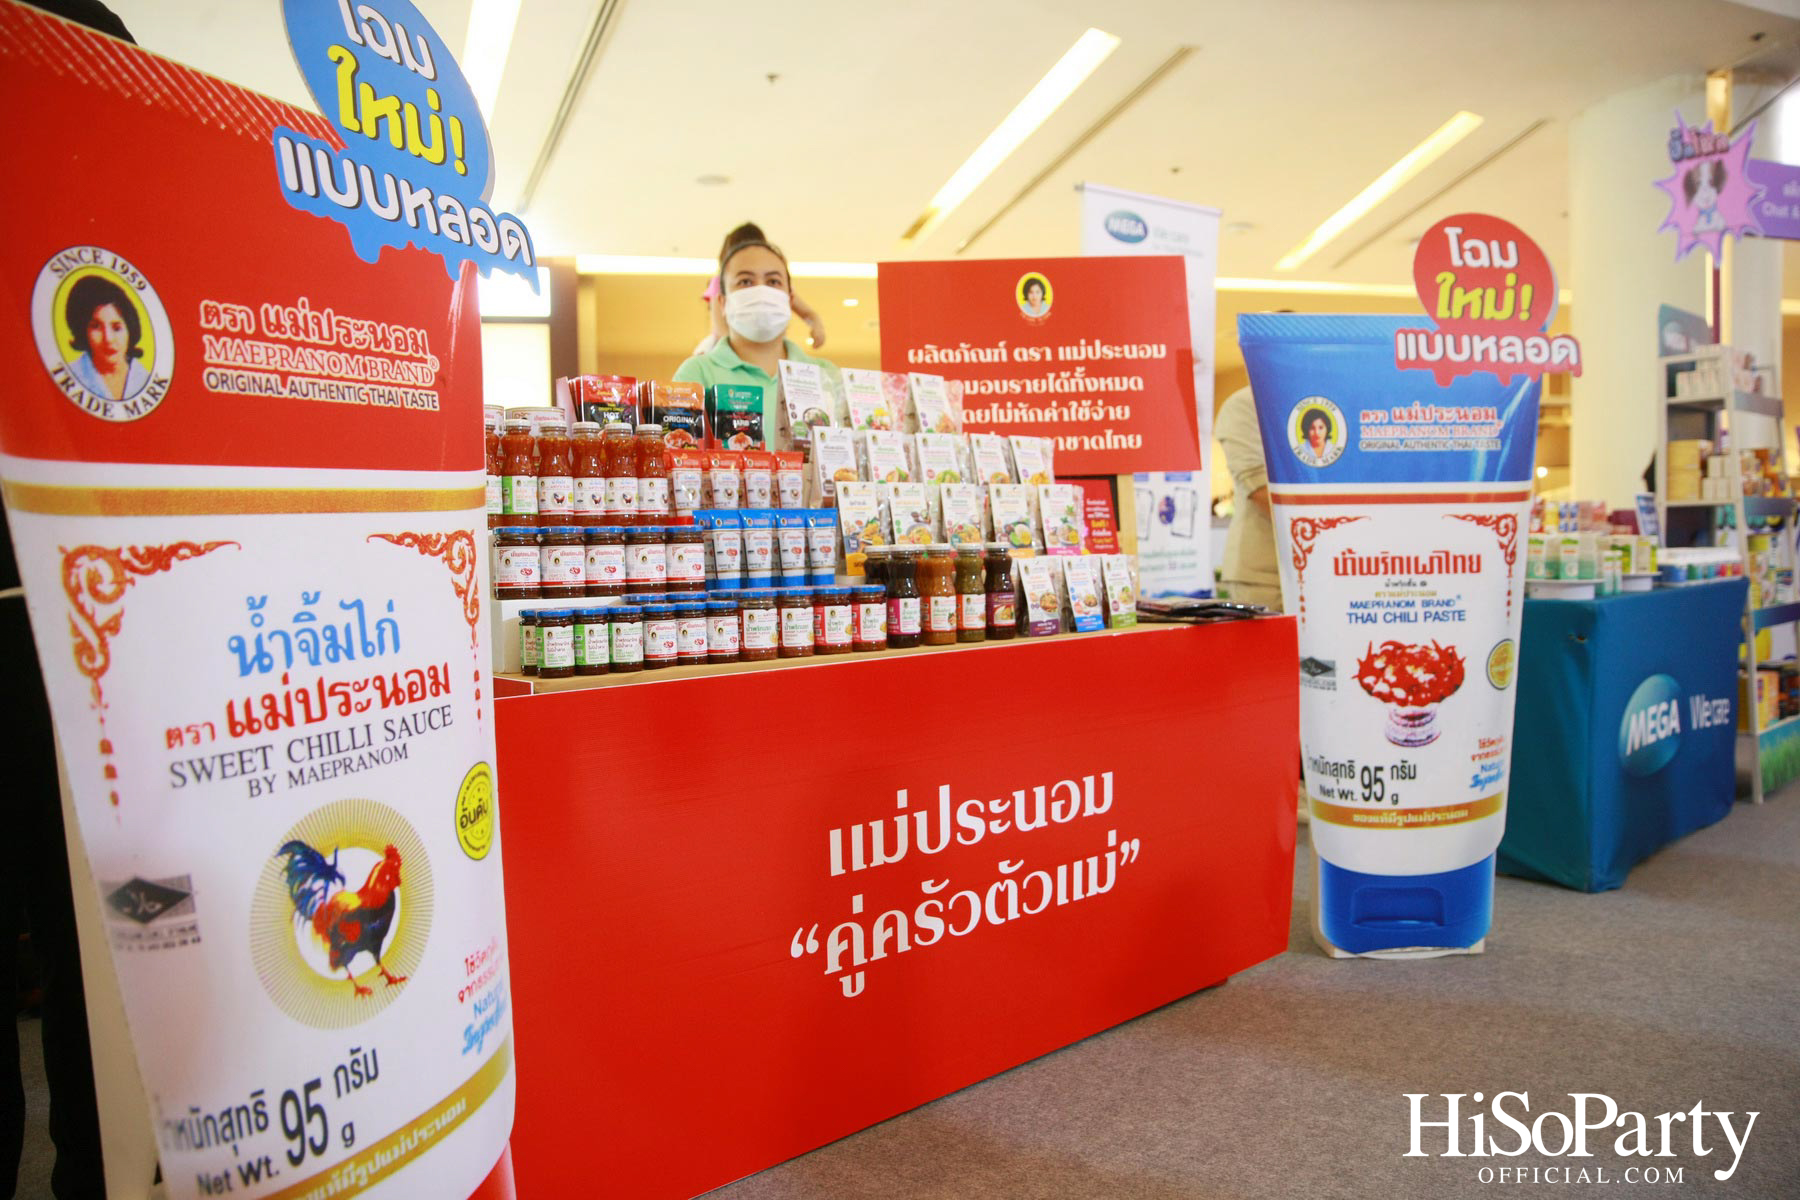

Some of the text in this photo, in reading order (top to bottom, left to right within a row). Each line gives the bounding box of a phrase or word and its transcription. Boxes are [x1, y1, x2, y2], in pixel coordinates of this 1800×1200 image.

[328, 45, 467, 175] ใหม่!
[279, 136, 534, 266] แบบหลอด
[50, 249, 147, 291] SINCE 1959
[1444, 226, 1519, 268] โฉม
[1435, 271, 1534, 320] ใหม่!
[202, 298, 429, 357] ตรา แม่ประนอม
[1397, 331, 1579, 366] แบบหลอด
[203, 336, 365, 378] MAEPRANOM
[908, 338, 1167, 364] ผลิตภัณฑ์ ตรา แม่ประนอม
[53, 363, 169, 418] TRADE MARK
[205, 370, 438, 409] ORIGINAL AUTHENTIC THAI TASTE
[961, 400, 1131, 424] ดยไม่หักค่าใช้จ่าย
[1392, 401, 1497, 422] แม่ประนอม
[1333, 548, 1482, 576] น้ำพริกเผาไทย
[1346, 609, 1467, 624] THAI CHILI PASTE
[1350, 600, 1415, 610] MAEPRANOM
[227, 590, 402, 677] น้ำจิ้มไก่
[165, 662, 452, 750] ตรา แม่ประนอม
[1626, 698, 1681, 756] MEGA
[169, 704, 454, 789] SWEET CHILLI SAUCE
[248, 743, 410, 799] BY MAEPRANOM
[1361, 766, 1385, 802] 95
[1390, 759, 1416, 780] กรัม
[1319, 784, 1335, 798] Net
[1391, 793, 1399, 805] g
[829, 771, 1114, 876] แม่ประนอม
[280, 1079, 329, 1167] 95
[334, 1045, 379, 1098] กรัม
[198, 1121, 355, 1196] Net Wt. g
